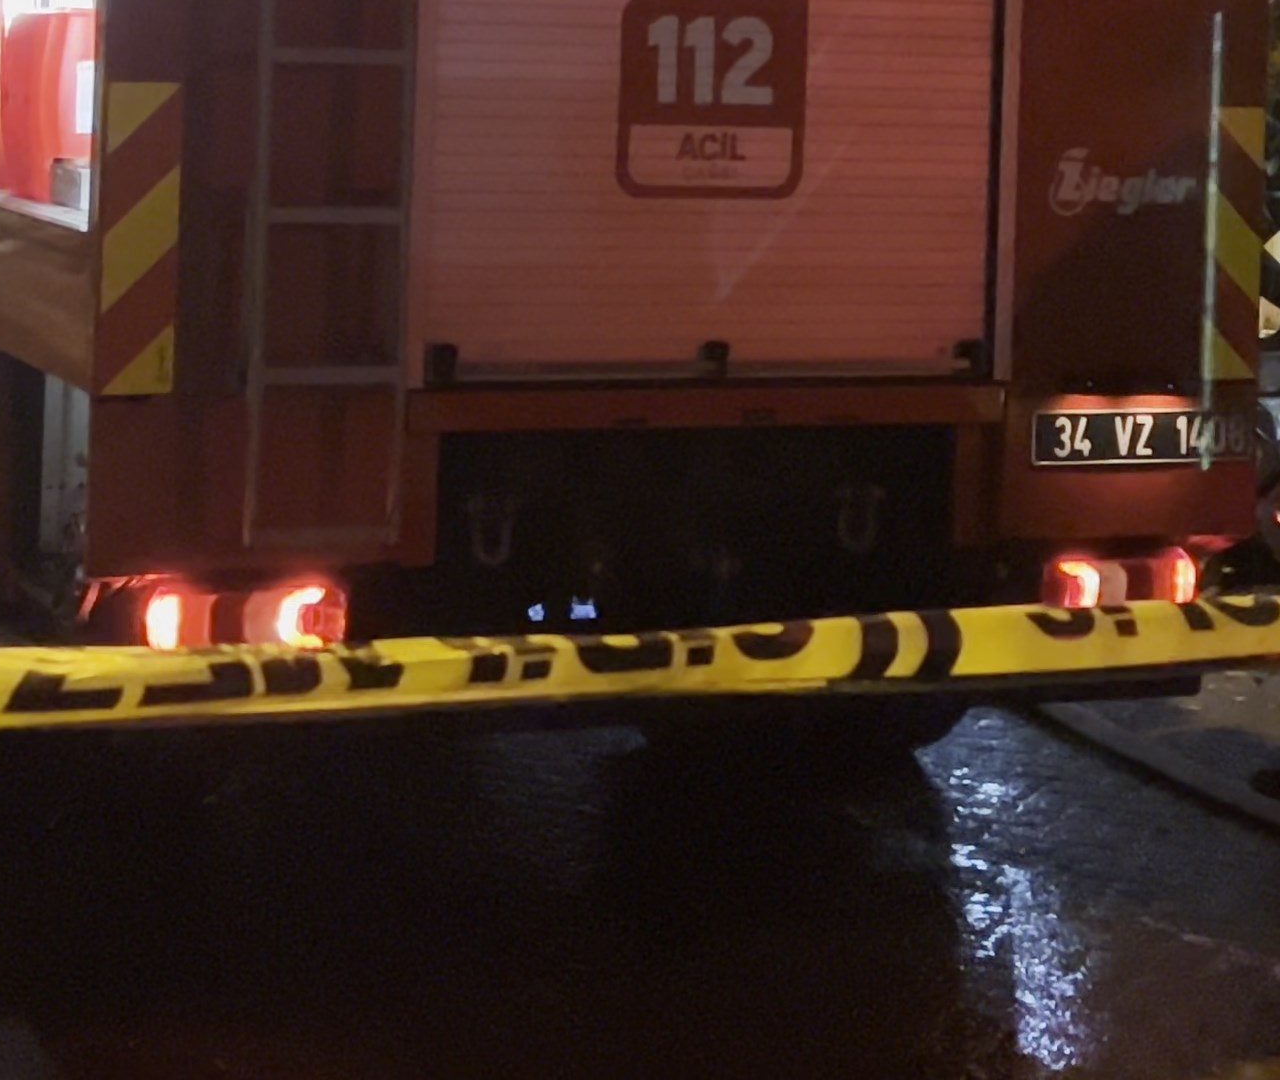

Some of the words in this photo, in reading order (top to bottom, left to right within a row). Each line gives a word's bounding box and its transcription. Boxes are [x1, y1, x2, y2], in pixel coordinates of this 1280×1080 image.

[647, 14, 774, 105] 112
[1053, 415, 1093, 458] 34
[1114, 414, 1154, 457] VZ
